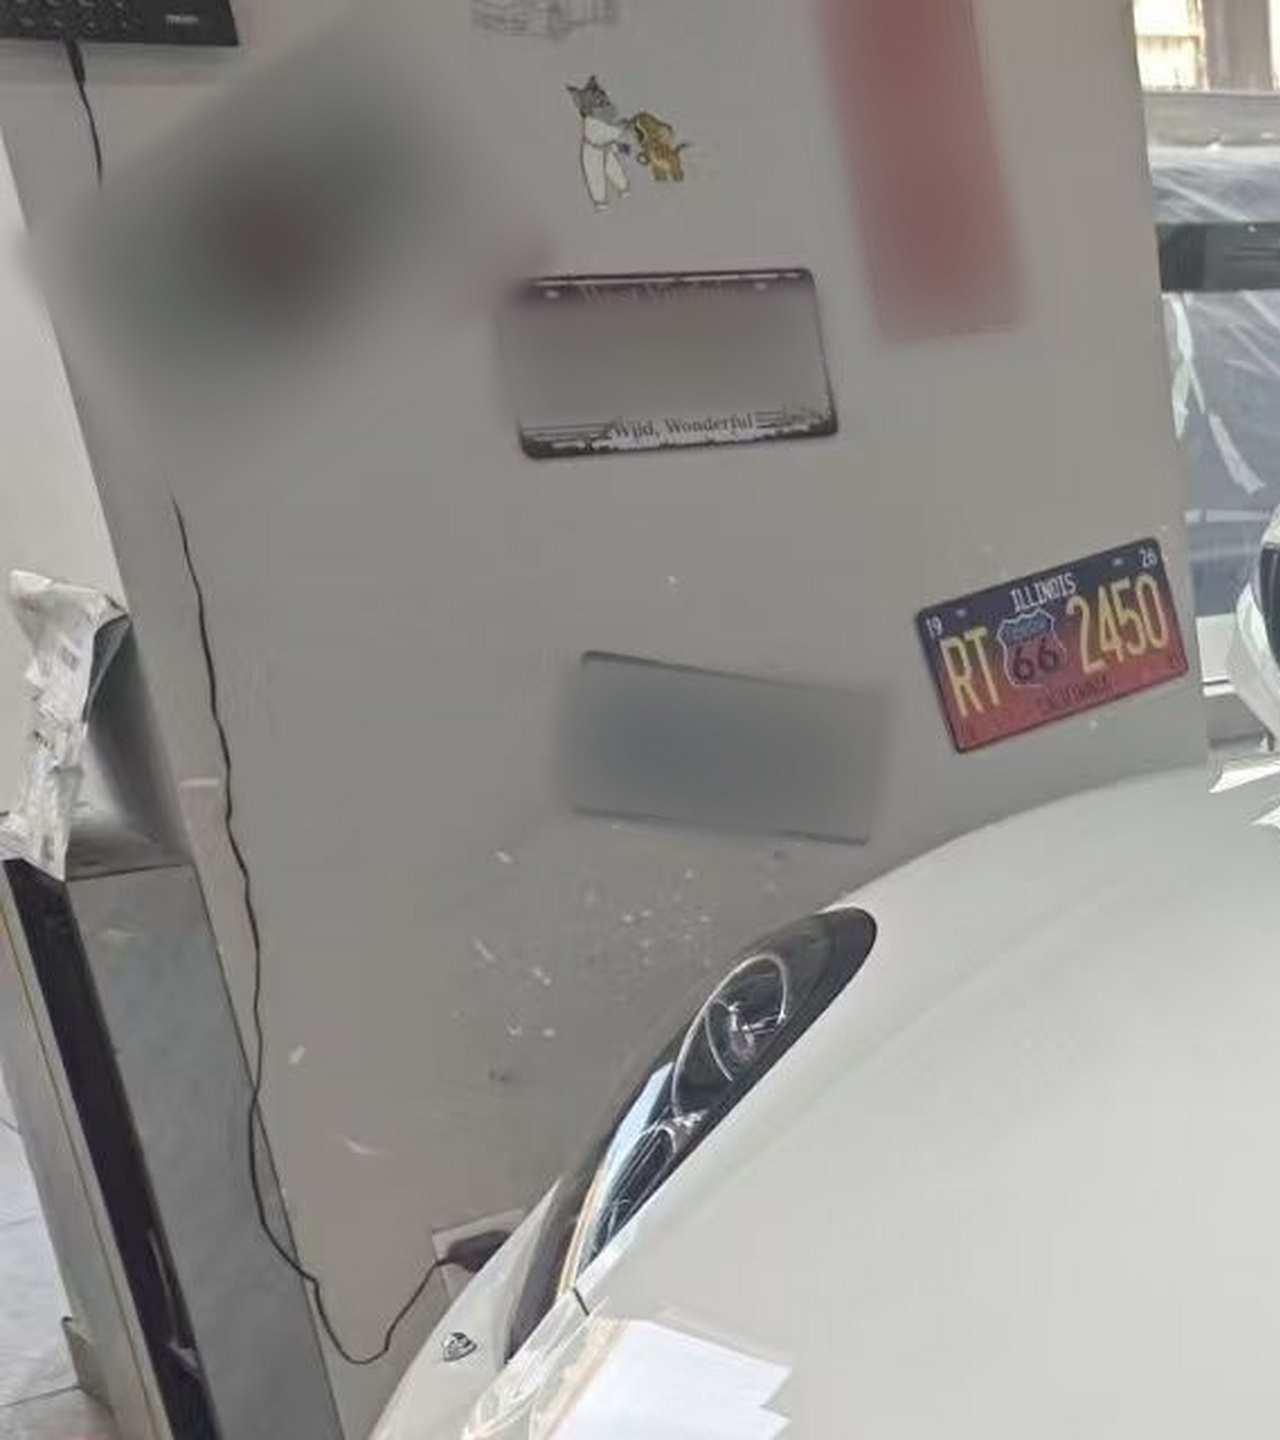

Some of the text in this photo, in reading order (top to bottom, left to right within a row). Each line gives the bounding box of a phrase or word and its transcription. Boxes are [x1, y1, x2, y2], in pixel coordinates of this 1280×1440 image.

[663, 413, 754, 434] Wonderful
[1009, 572, 1078, 613] ILLINOIS
[939, 626, 1000, 718] RT
[1012, 639, 1061, 681] 66
[1065, 573, 1170, 674] 2450
